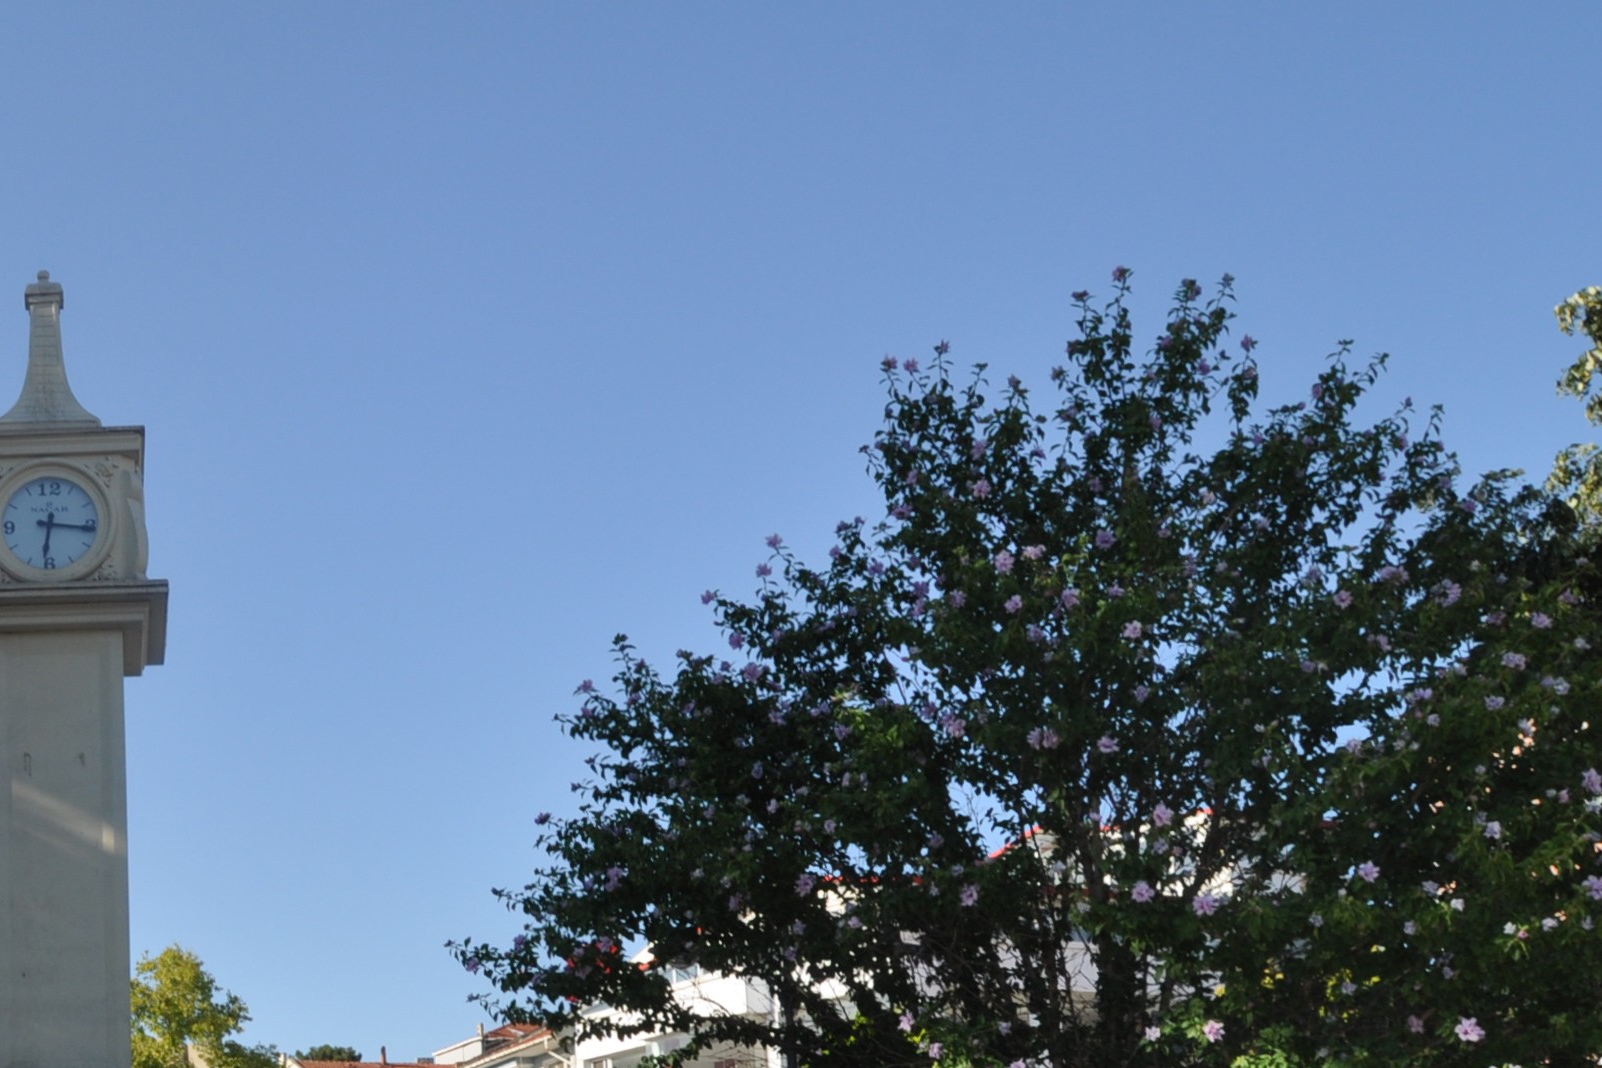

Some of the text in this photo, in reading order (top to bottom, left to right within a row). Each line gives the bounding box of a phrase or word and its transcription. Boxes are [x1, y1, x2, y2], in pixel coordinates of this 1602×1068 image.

[38, 482, 62, 497] 12
[3, 520, 16, 536] 9
[43, 556, 56, 570] 6
